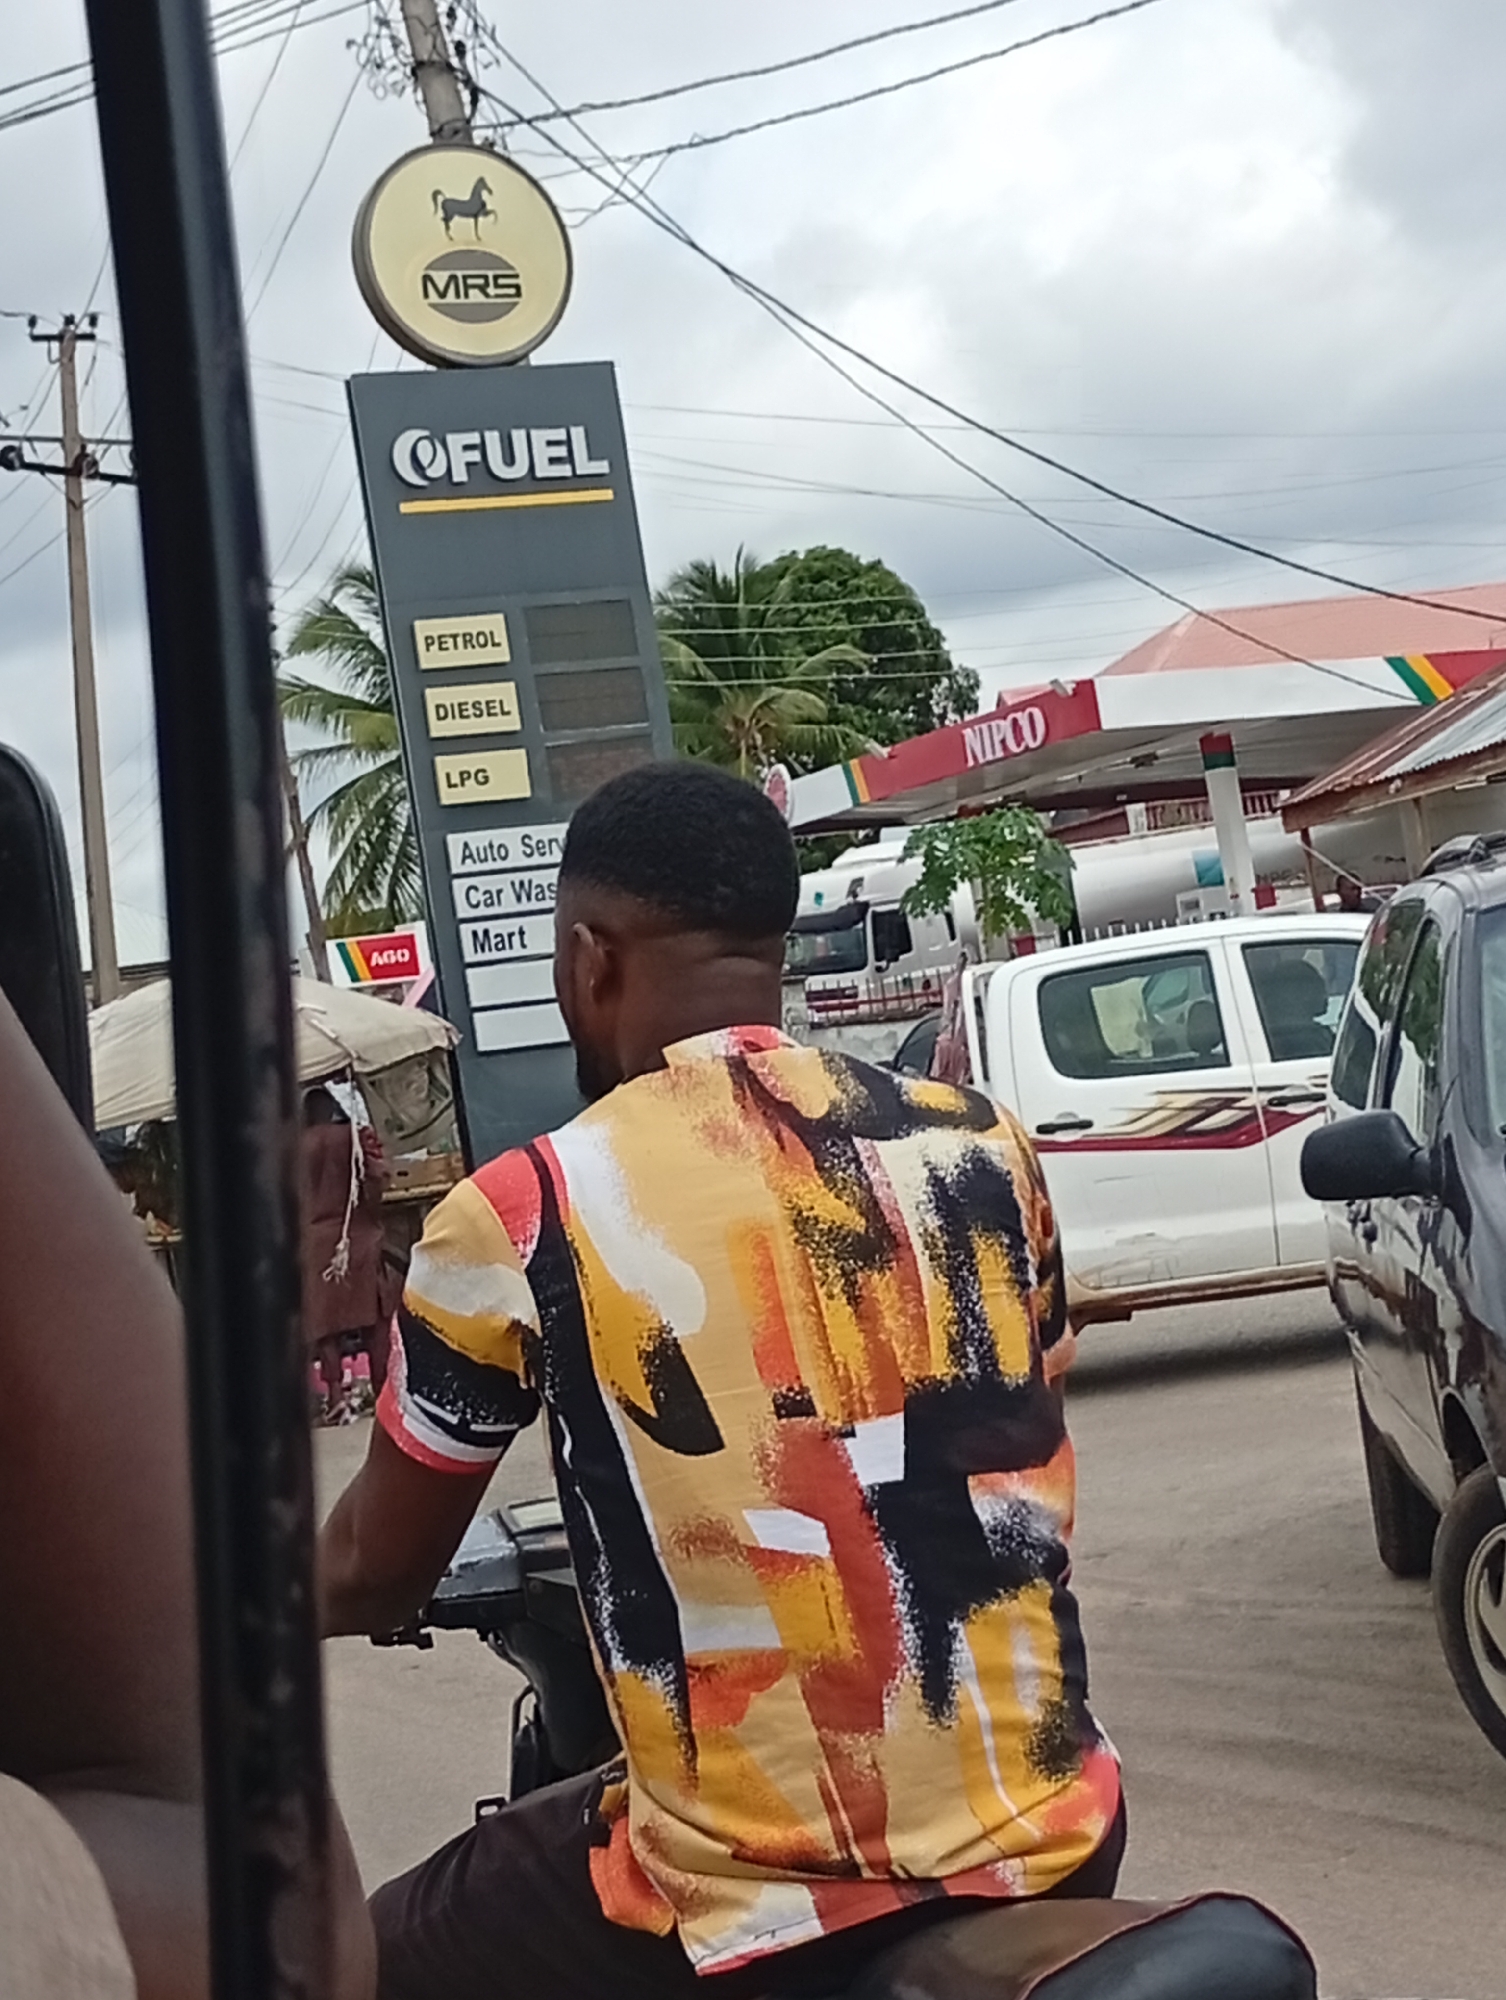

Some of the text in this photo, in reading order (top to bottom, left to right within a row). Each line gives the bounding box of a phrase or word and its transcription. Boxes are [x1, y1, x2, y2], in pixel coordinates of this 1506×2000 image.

[421, 273, 522, 300] MRS
[424, 630, 502, 652] PETROL
[435, 698, 511, 721] DIESEL
[962, 707, 1046, 768] NIPCO
[445, 768, 490, 788] LPG
[460, 840, 509, 866] Auto
[465, 884, 504, 909] Car
[471, 925, 527, 954] Mart
[370, 948, 410, 968] AGO
